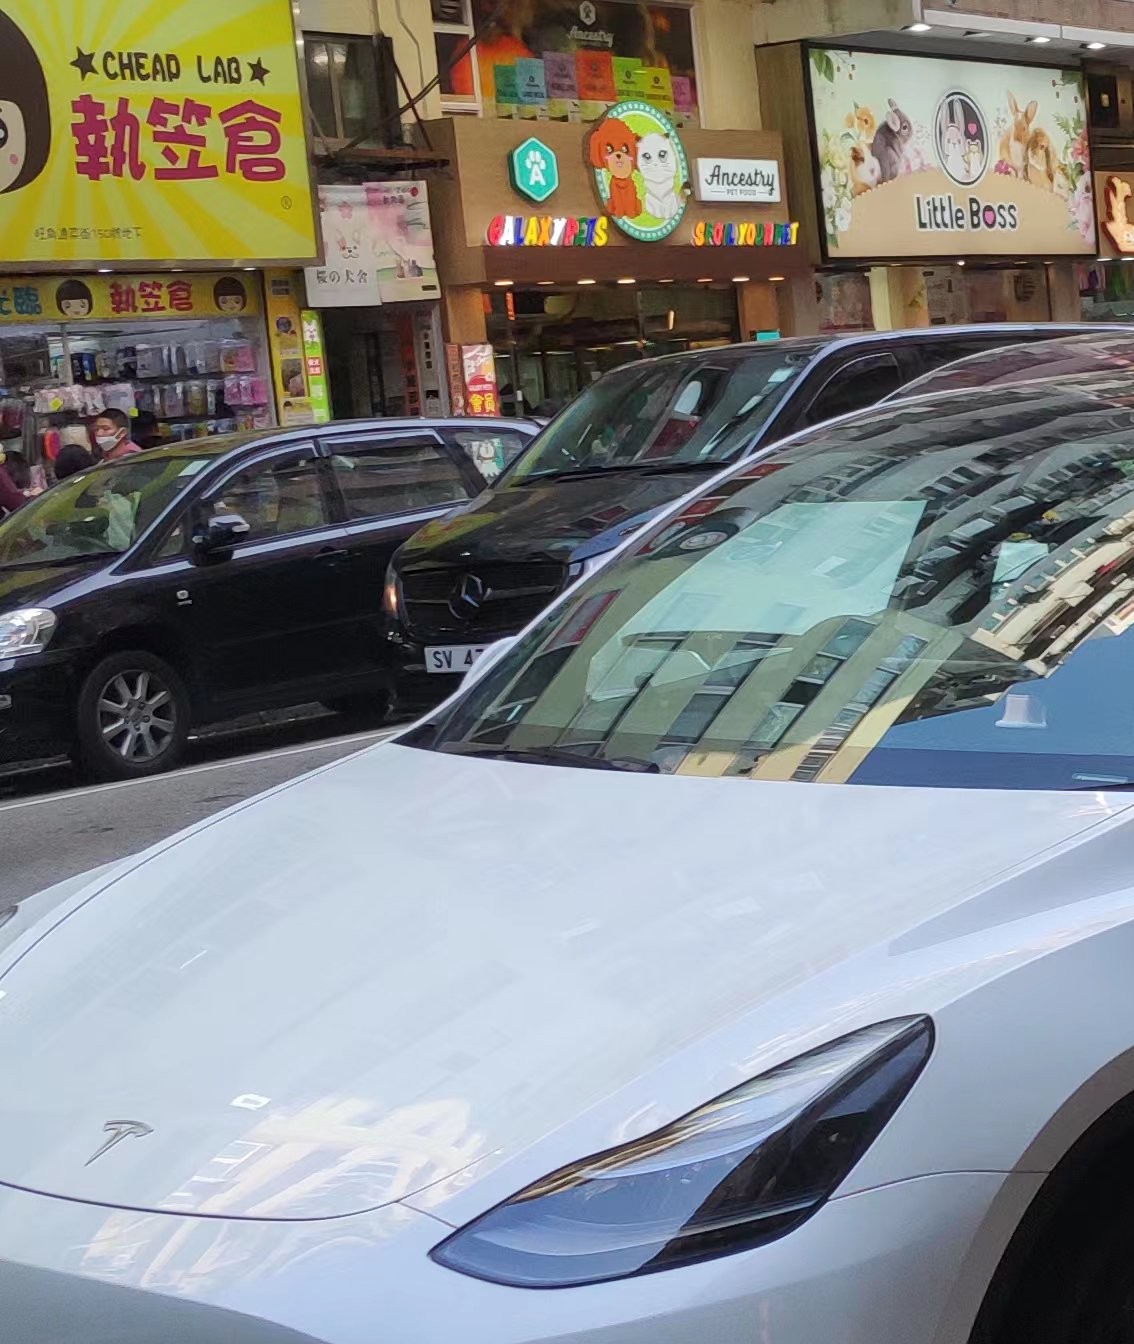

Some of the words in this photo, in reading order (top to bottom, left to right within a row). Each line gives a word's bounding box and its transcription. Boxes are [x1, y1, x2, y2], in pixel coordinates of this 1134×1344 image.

[102, 50, 181, 83] CHEAP
[196, 55, 242, 85] LAB
[71, 93, 286, 182] 執笠倉
[705, 164, 775, 196] Ancestry
[916, 194, 965, 229] Little
[969, 197, 1017, 229] Boss
[433, 650, 453, 669] SV
[463, 648, 485, 665] 4
